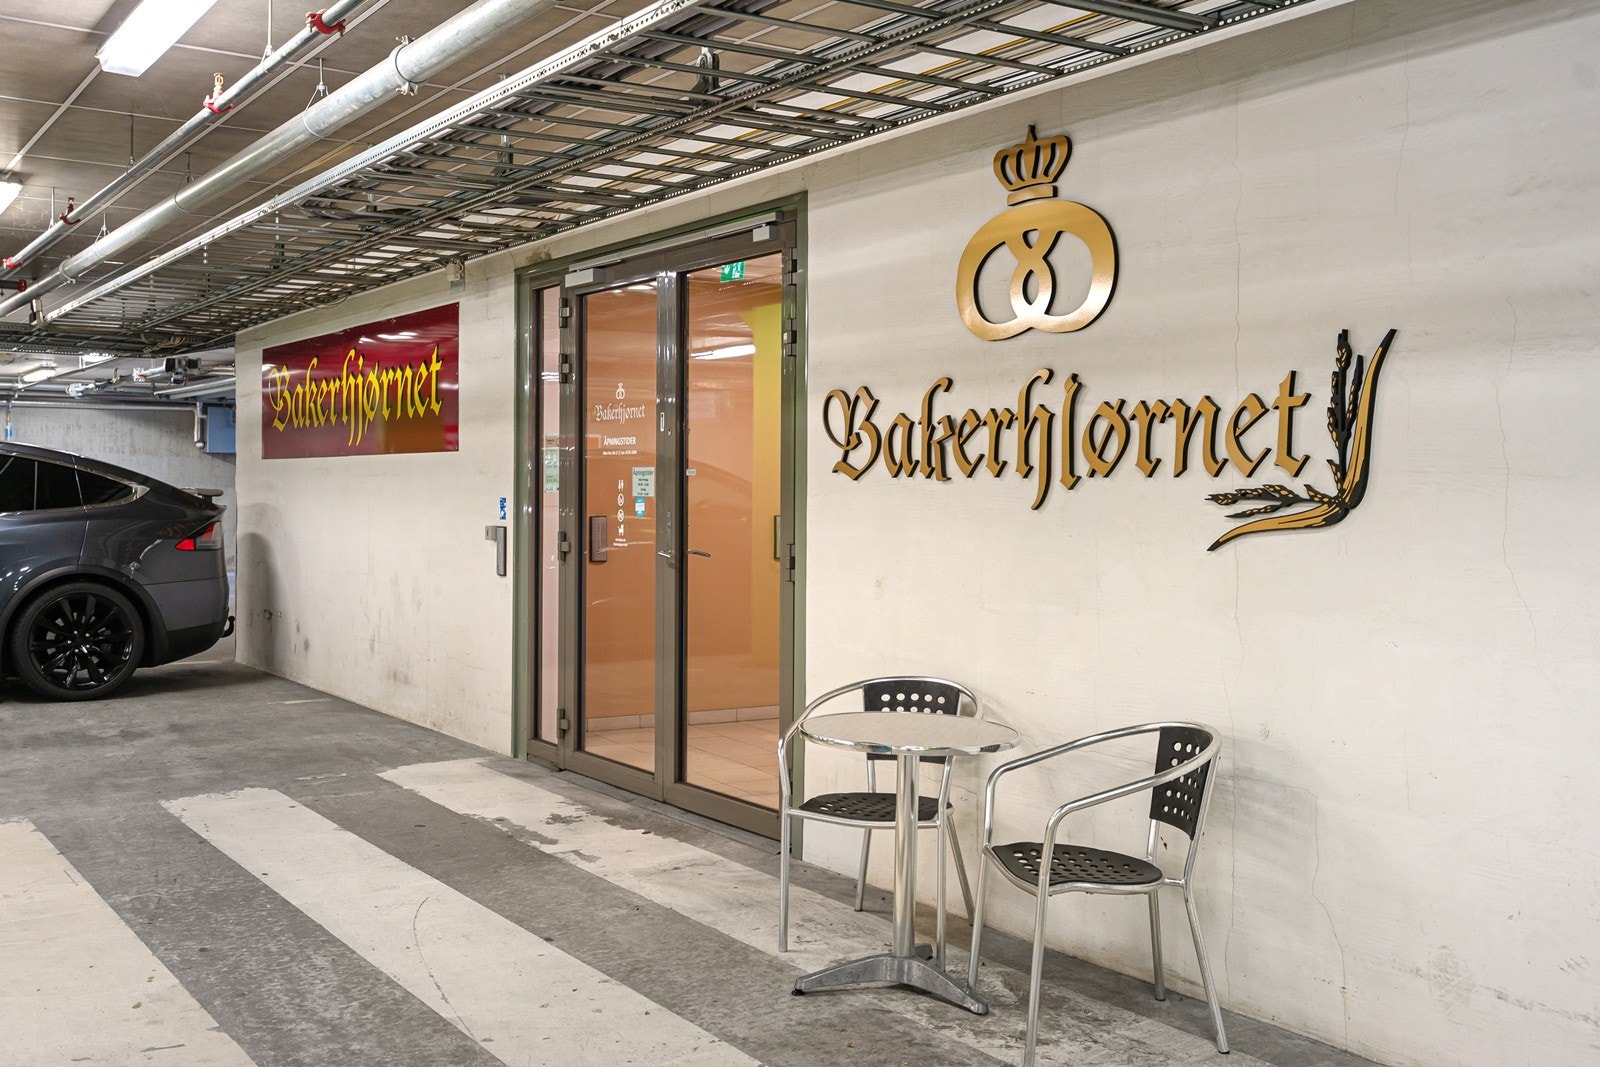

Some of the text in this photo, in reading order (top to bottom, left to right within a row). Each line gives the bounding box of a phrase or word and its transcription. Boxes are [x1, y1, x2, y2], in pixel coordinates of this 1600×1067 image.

[269, 344, 444, 446] Bakerhjørnet
[595, 402, 645, 424] Bakerhjørnet
[604, 436, 636, 445] ÅPNINGSTIDER
